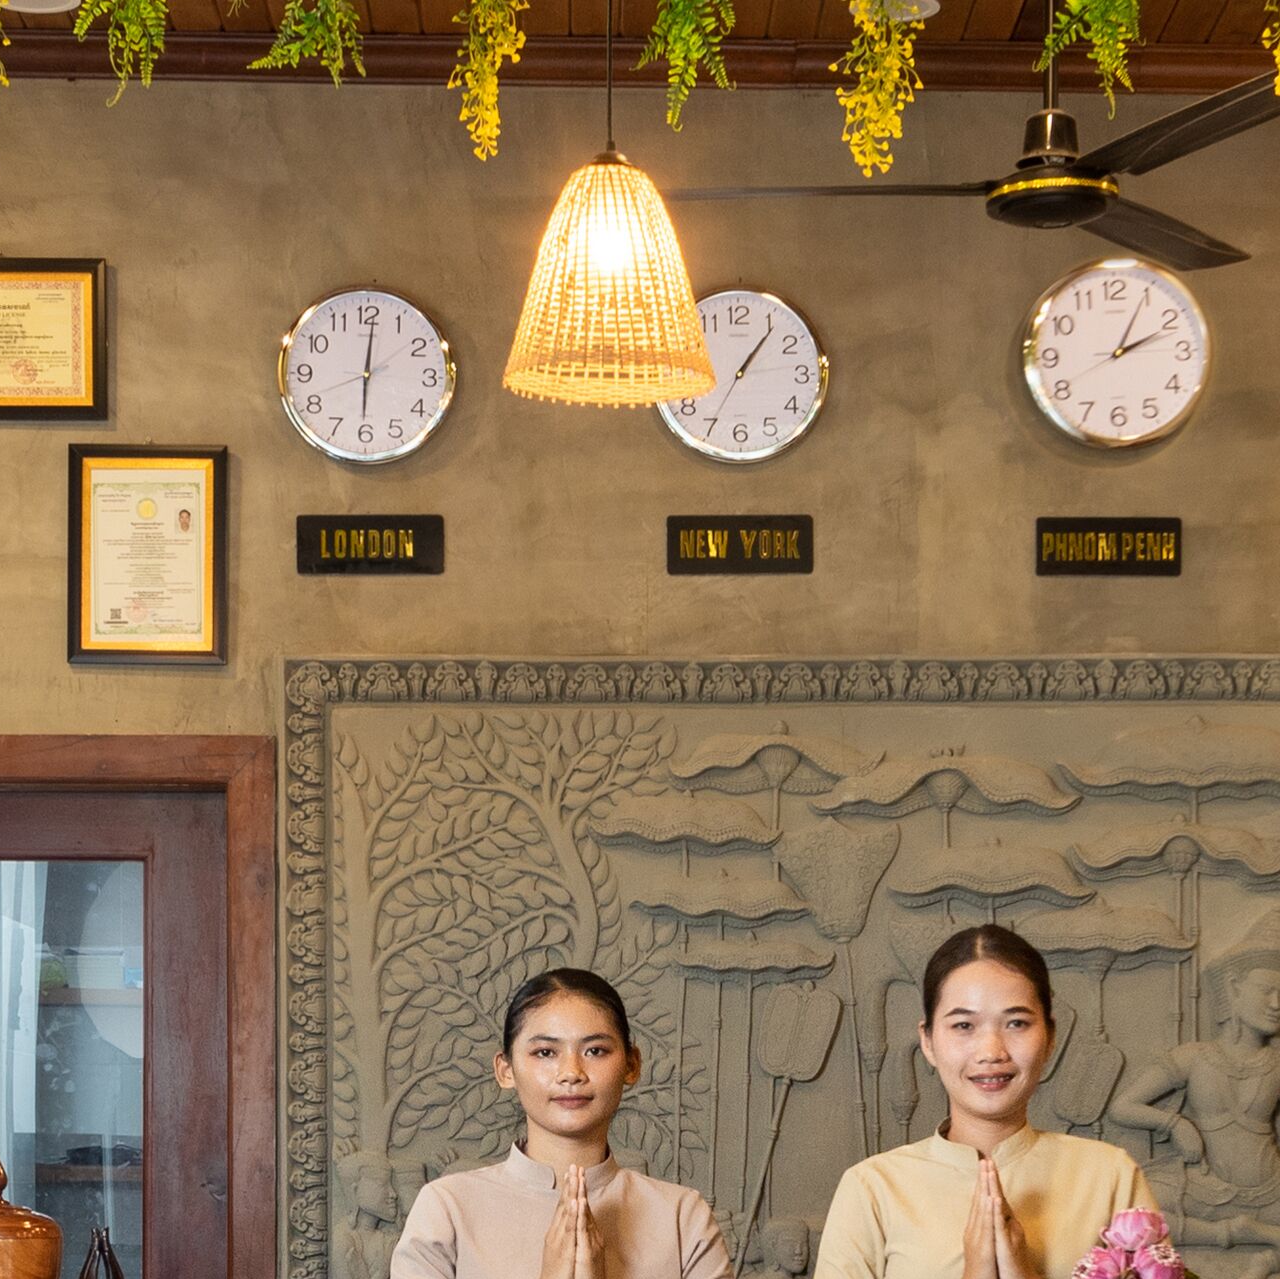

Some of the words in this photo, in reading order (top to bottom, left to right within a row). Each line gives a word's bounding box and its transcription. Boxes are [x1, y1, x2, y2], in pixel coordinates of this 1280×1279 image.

[1074, 290, 1092, 310] 11
[1102, 280, 1126, 301] 12
[330, 312, 347, 332] 11
[395, 314, 401, 334] 1
[727, 306, 750, 326] 12
[1053, 315, 1074, 336] 10
[1161, 309, 1178, 330] 2
[308, 334, 328, 354] 10
[411, 338, 427, 357] 2
[782, 335, 798, 354] 2
[1174, 340, 1192, 362] 3
[1042, 348, 1058, 368] 9
[296, 364, 313, 383] 9
[422, 368, 438, 388] 3
[794, 364, 810, 384] 3
[1054, 380, 1070, 400] 8
[1164, 374, 1180, 394] 4
[306, 394, 322, 414] 8
[410, 398, 426, 418] 4
[784, 395, 799, 414] 4
[1078, 401, 1094, 422] 7
[1142, 398, 1158, 419] 5
[328, 416, 344, 436] 7
[1110, 406, 1128, 426] 6
[358, 424, 374, 443] 6
[388, 418, 404, 438] 5
[704, 418, 718, 437] 7
[732, 424, 748, 442] 6
[762, 416, 778, 437] 5
[320, 529, 414, 558] LONDON
[680, 530, 728, 558] NEW
[740, 530, 800, 559] YORK
[1042, 532, 1116, 560] PHNOM
[1122, 532, 1175, 560] PENH
